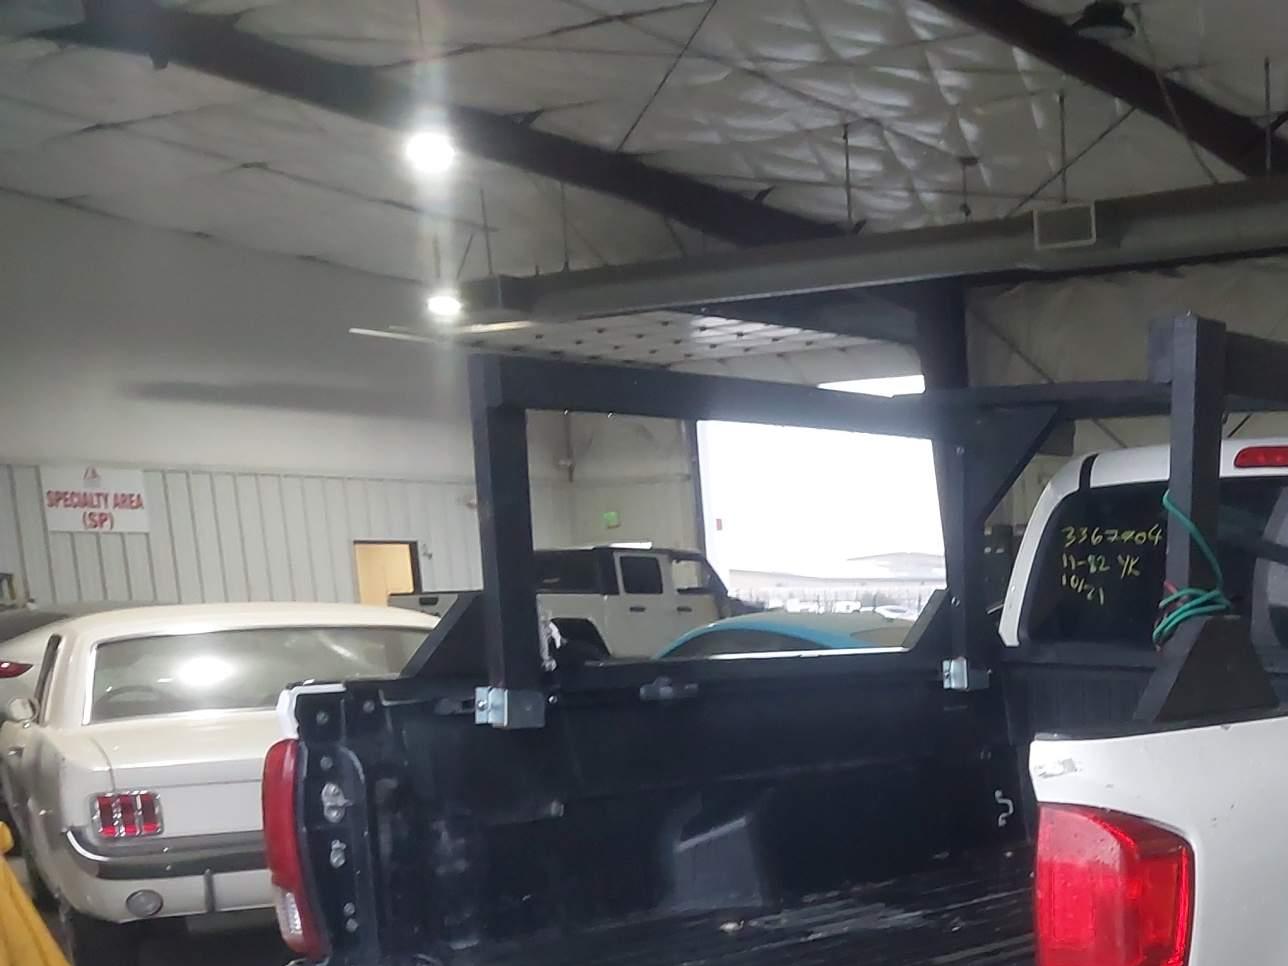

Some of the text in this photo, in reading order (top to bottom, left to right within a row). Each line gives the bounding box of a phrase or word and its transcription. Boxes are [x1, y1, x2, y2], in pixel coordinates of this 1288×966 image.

[46, 490, 144, 510] SPECIALTY AREA
[82, 511, 114, 531] (SP)
